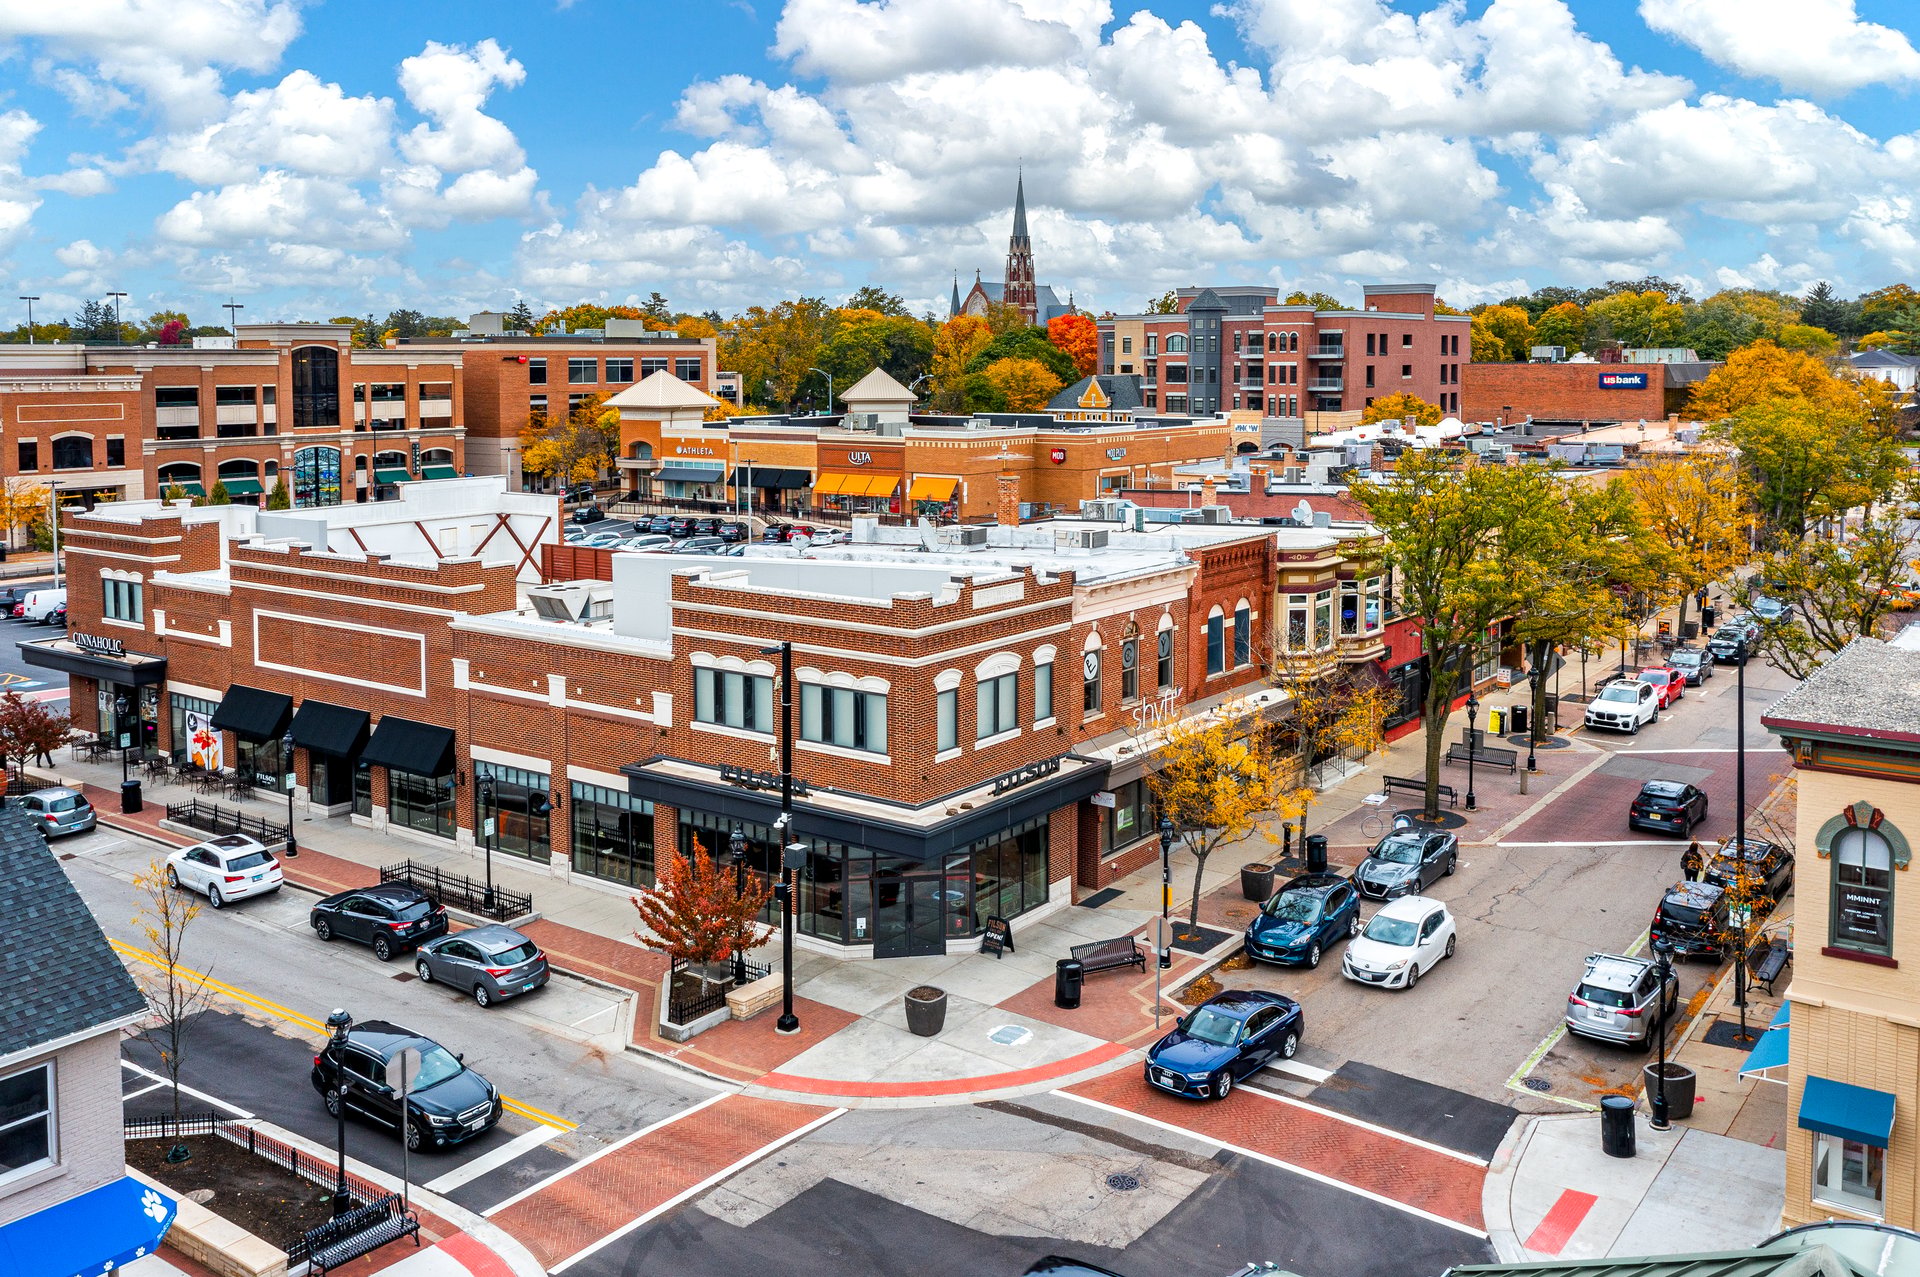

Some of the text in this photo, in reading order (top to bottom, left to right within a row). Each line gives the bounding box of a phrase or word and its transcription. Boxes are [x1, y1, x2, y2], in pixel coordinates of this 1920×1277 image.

[683, 447, 714, 455] ATHLETA
[851, 451, 871, 463] ULTA
[1052, 452, 1064, 460] MOD
[72, 631, 122, 652] CINNAHOLIC
[1132, 688, 1178, 731] shyft
[719, 763, 807, 796] FILSON
[995, 756, 1061, 796] FILSON
[1846, 894, 1881, 905] MMINNT
